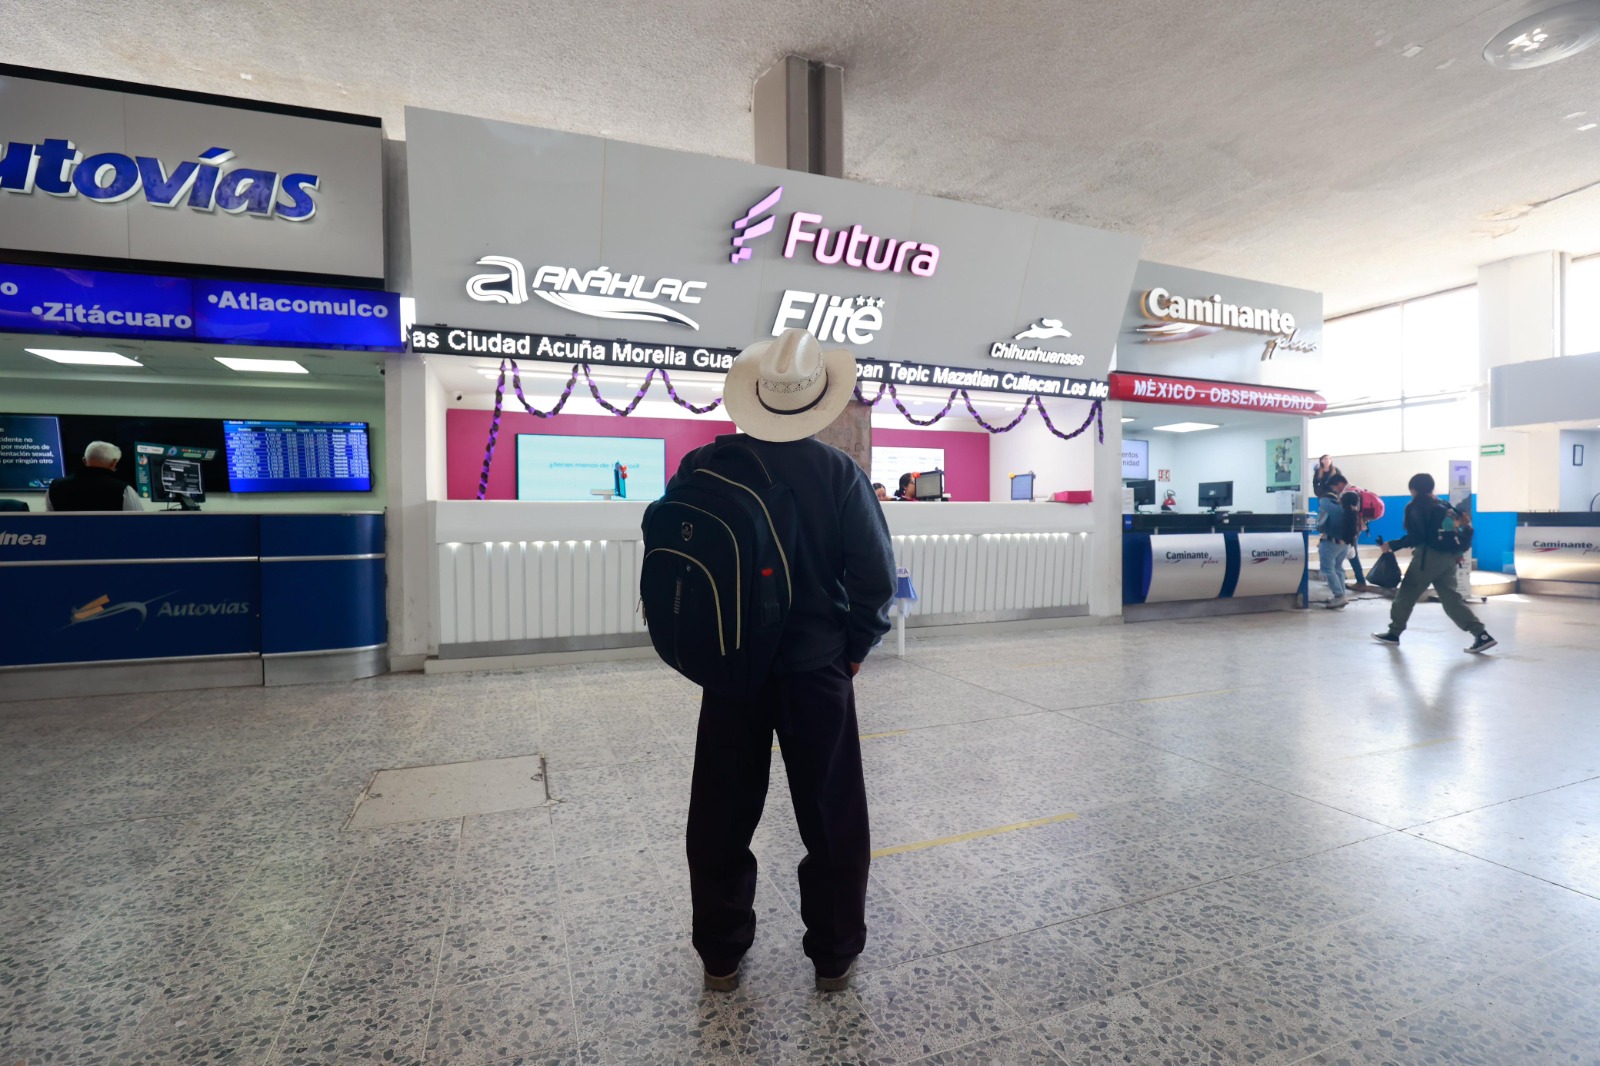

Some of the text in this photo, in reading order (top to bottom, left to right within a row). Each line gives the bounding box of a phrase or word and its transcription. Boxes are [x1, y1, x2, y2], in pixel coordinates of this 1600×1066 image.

[783, 211, 940, 277] Futura
[532, 266, 707, 304] ANÁHUAC
[43, 301, 192, 329] Zitácuaro
[218, 290, 389, 318] Atlacomulco
[772, 290, 883, 345] Elite
[1149, 287, 1296, 335] Caminante
[412, 331, 440, 348] as
[447, 329, 531, 356] Ciudad
[536, 337, 605, 362] Acuña
[611, 344, 687, 366] Morelia
[692, 348, 738, 369] Gua
[889, 362, 930, 384] Tepic
[933, 368, 999, 389] Mazatlan
[1002, 373, 1061, 394] Culiacan
[1062, 379, 1087, 396] Los
[991, 342, 1085, 366] Chihuahuenses
[1133, 379, 1196, 400] MÉXICO
[1210, 387, 1315, 410] OBSERVATORIO
[1165, 550, 1209, 560] Caminante
[1533, 541, 1593, 549] Caminante
